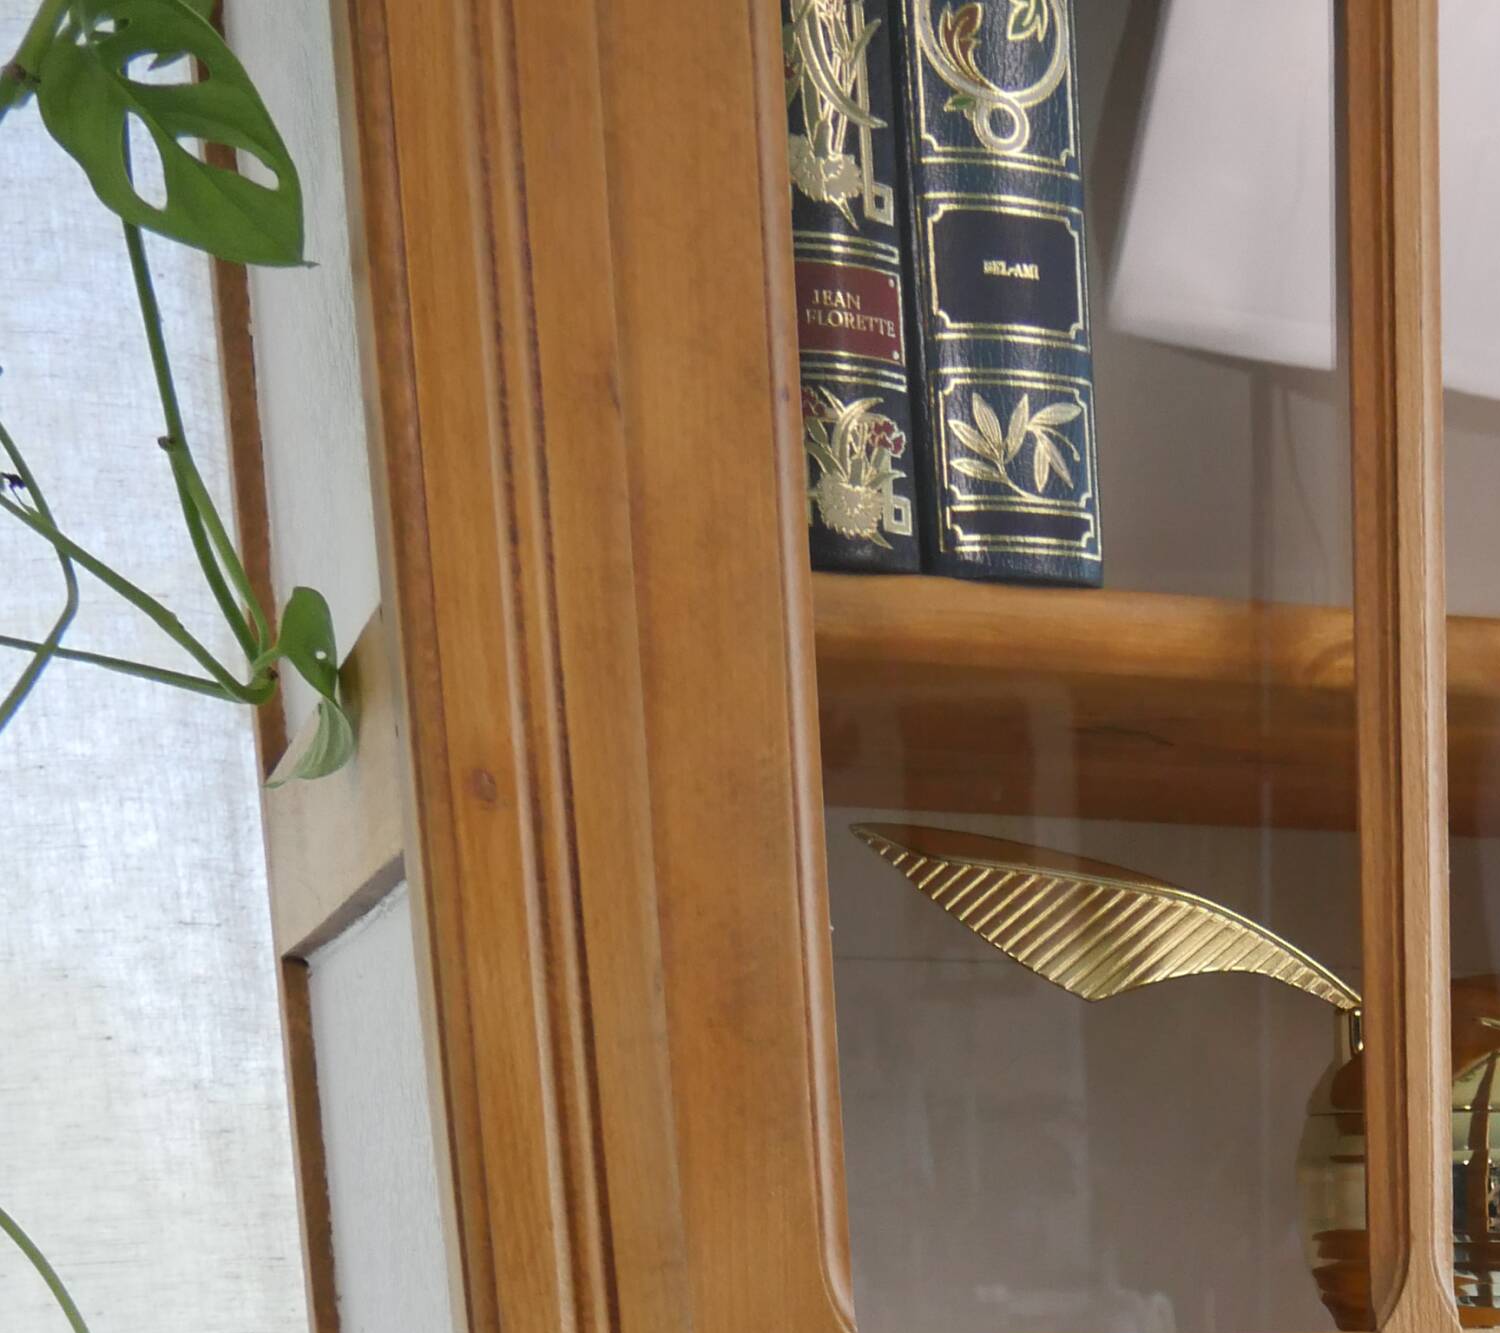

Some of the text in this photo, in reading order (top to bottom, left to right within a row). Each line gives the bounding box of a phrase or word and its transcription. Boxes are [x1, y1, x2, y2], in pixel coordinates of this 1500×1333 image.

[983, 259, 1040, 281] BEL-AMI
[812, 288, 861, 310] JEAN
[806, 309, 897, 339] FLORETTE
